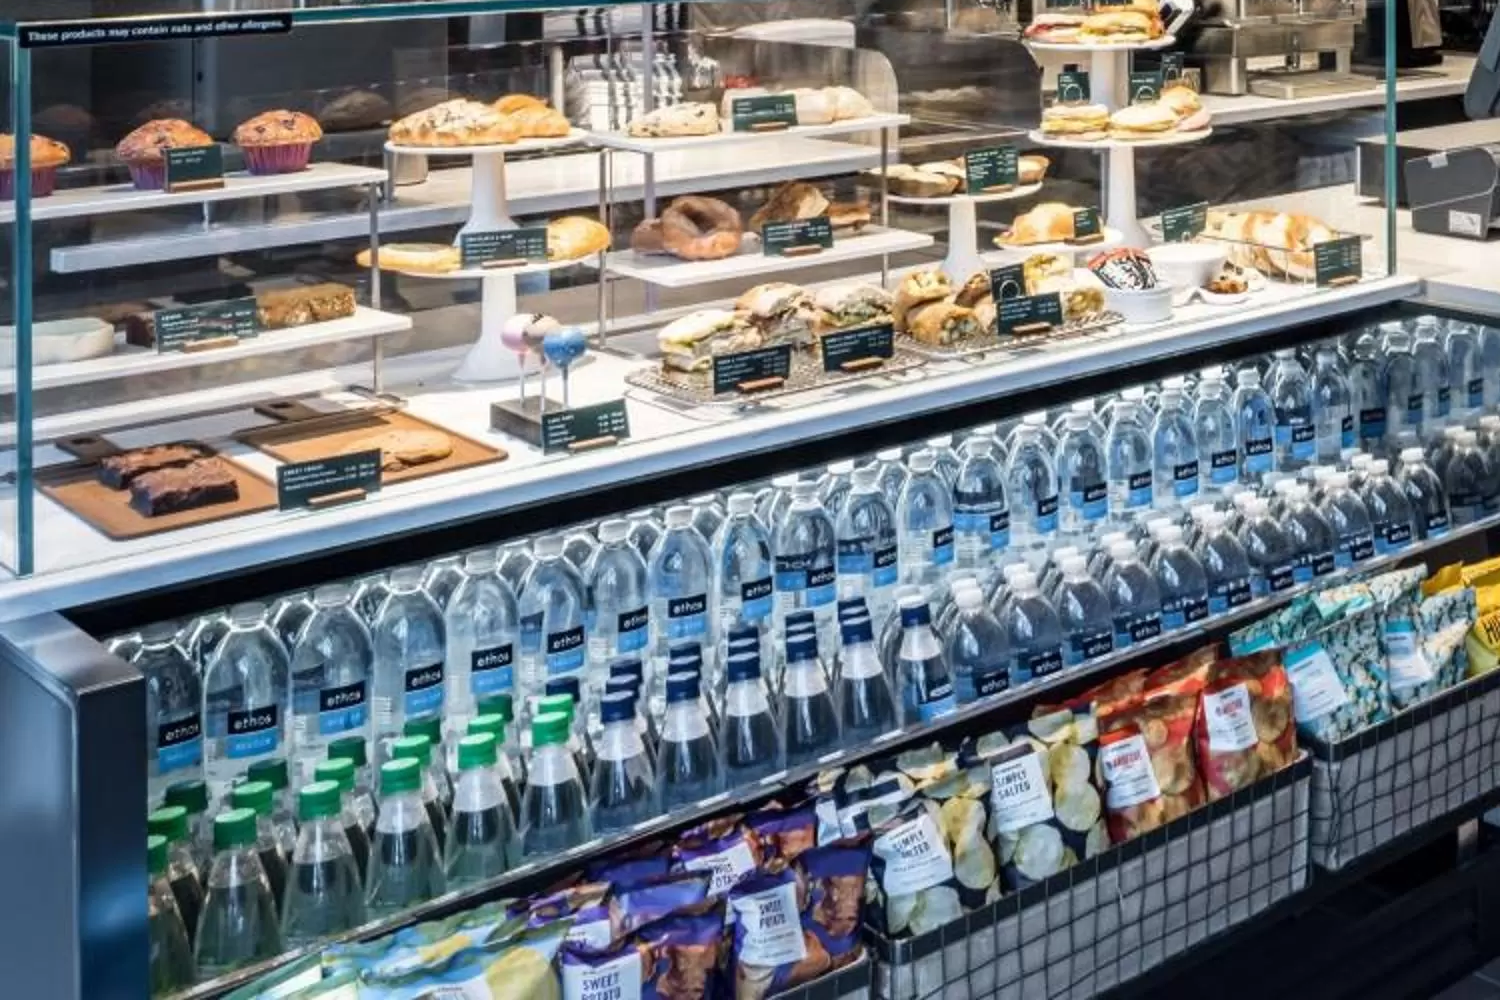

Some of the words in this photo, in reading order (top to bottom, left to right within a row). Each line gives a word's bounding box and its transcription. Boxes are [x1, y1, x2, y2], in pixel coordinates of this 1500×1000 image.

[28, 31, 58, 42] These
[61, 29, 105, 42] products
[108, 29, 129, 39] may
[132, 25, 169, 36] contain
[172, 24, 192, 33] nuts
[195, 22, 213, 32] and
[673, 600, 703, 615] ethos
[553, 633, 581, 649] ethos
[477, 651, 509, 667] ethos
[411, 670, 441, 686] ethos
[327, 690, 361, 707] ethos
[234, 713, 272, 730] ethos
[165, 724, 199, 741] ethos
[995, 770, 1028, 786] SIMPLY
[998, 782, 1031, 799] SALTED
[759, 899, 782, 914] SWEET
[759, 913, 787, 929] POTATO
[583, 972, 620, 990] SWEET
